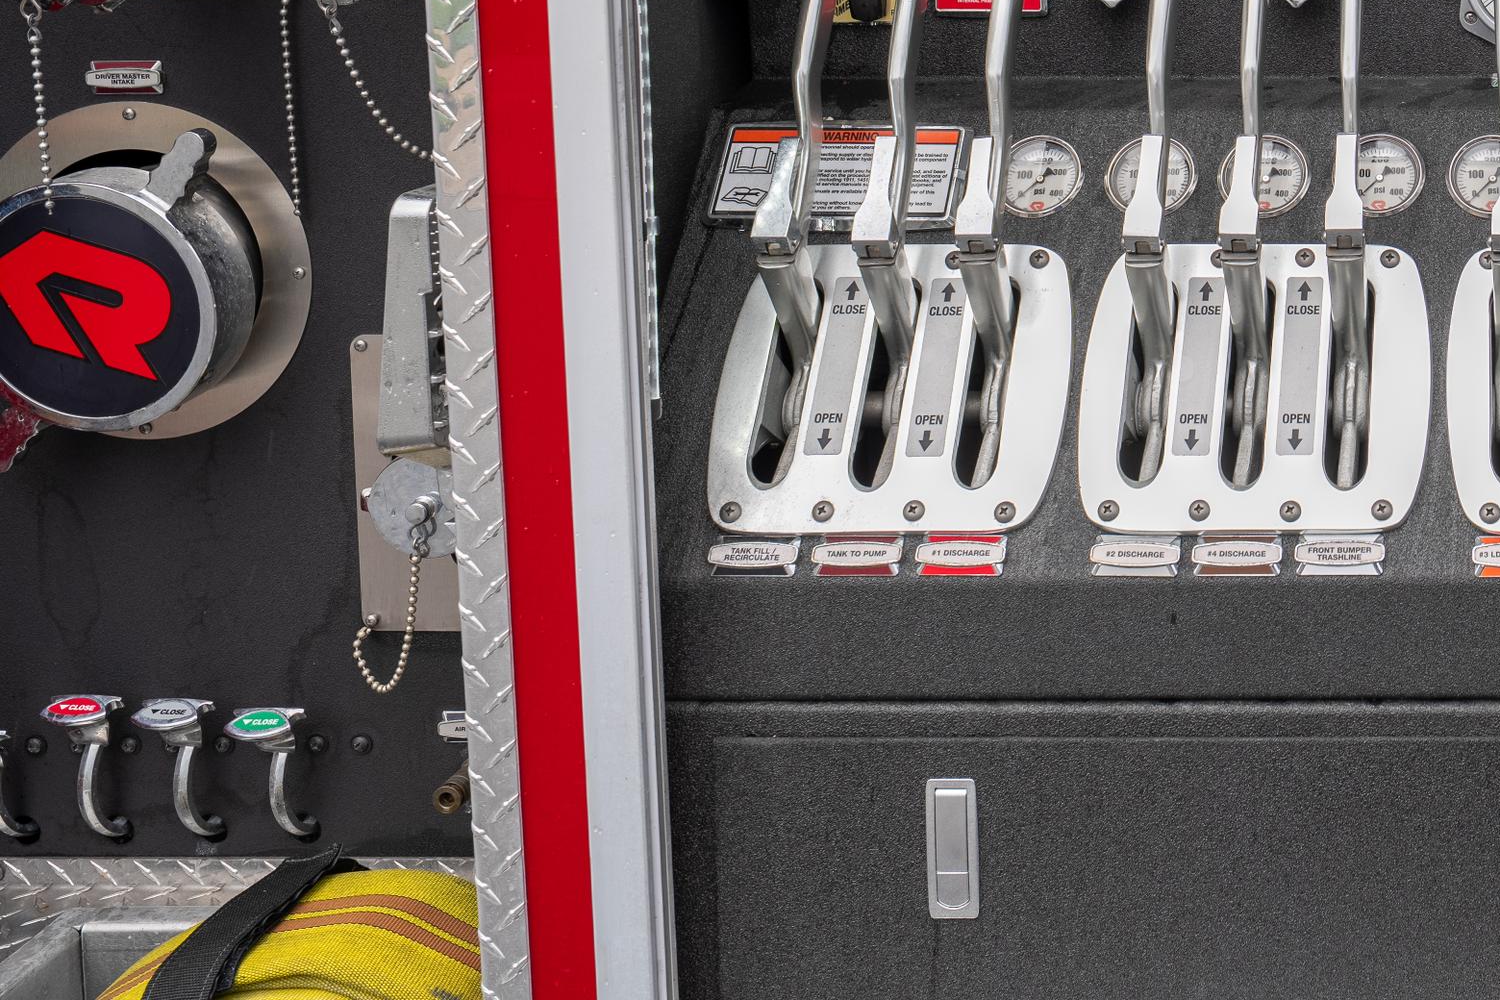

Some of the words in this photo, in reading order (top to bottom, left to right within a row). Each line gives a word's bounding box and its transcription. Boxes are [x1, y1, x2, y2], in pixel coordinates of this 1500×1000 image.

[1017, 170, 1032, 179] 100
[1468, 170, 1484, 179] 100
[832, 304, 865, 315] CLOSE
[929, 306, 962, 316] CLOSE
[814, 413, 842, 424] OPEN
[915, 415, 943, 425] OPEN
[723, 554, 780, 562] RECIRCULATE
[67, 703, 96, 712] CLOSE
[252, 718, 279, 726] CLOSE
